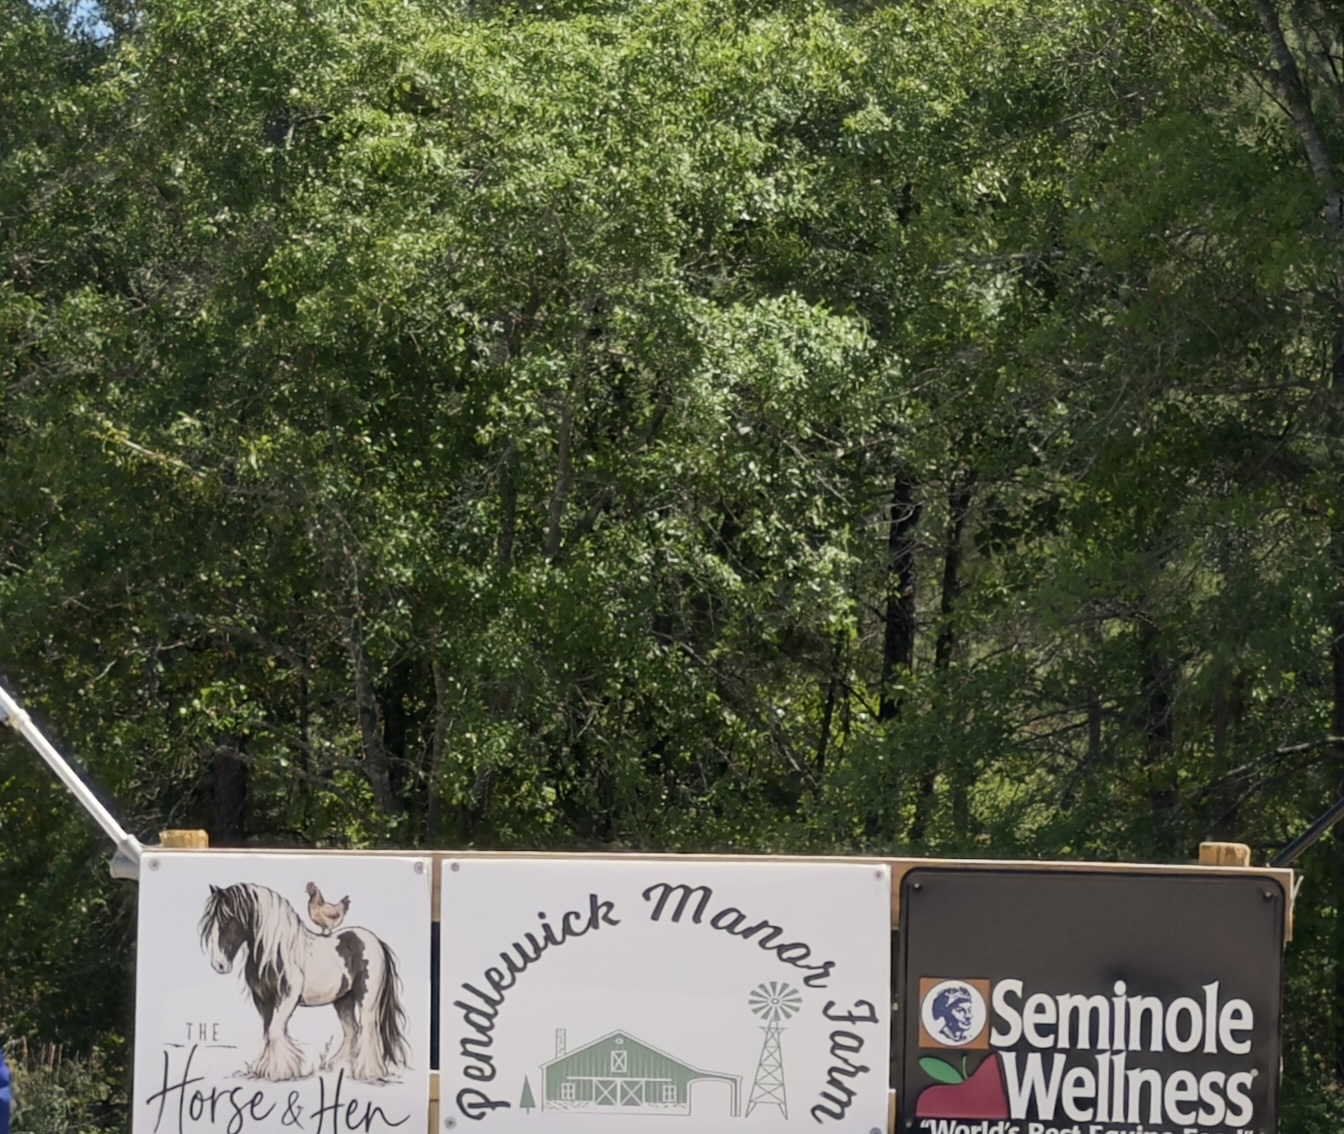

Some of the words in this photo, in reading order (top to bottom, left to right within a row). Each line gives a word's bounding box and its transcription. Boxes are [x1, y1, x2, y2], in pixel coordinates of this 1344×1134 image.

[186, 1022, 221, 1041] THE
[454, 893, 621, 1121] Pendlewick
[641, 881, 836, 989] Manor
[810, 999, 879, 1125] Farm
[989, 978, 1254, 1055] Seminole
[281, 1091, 305, 1129] &
[999, 1050, 1254, 1127] Wellness
